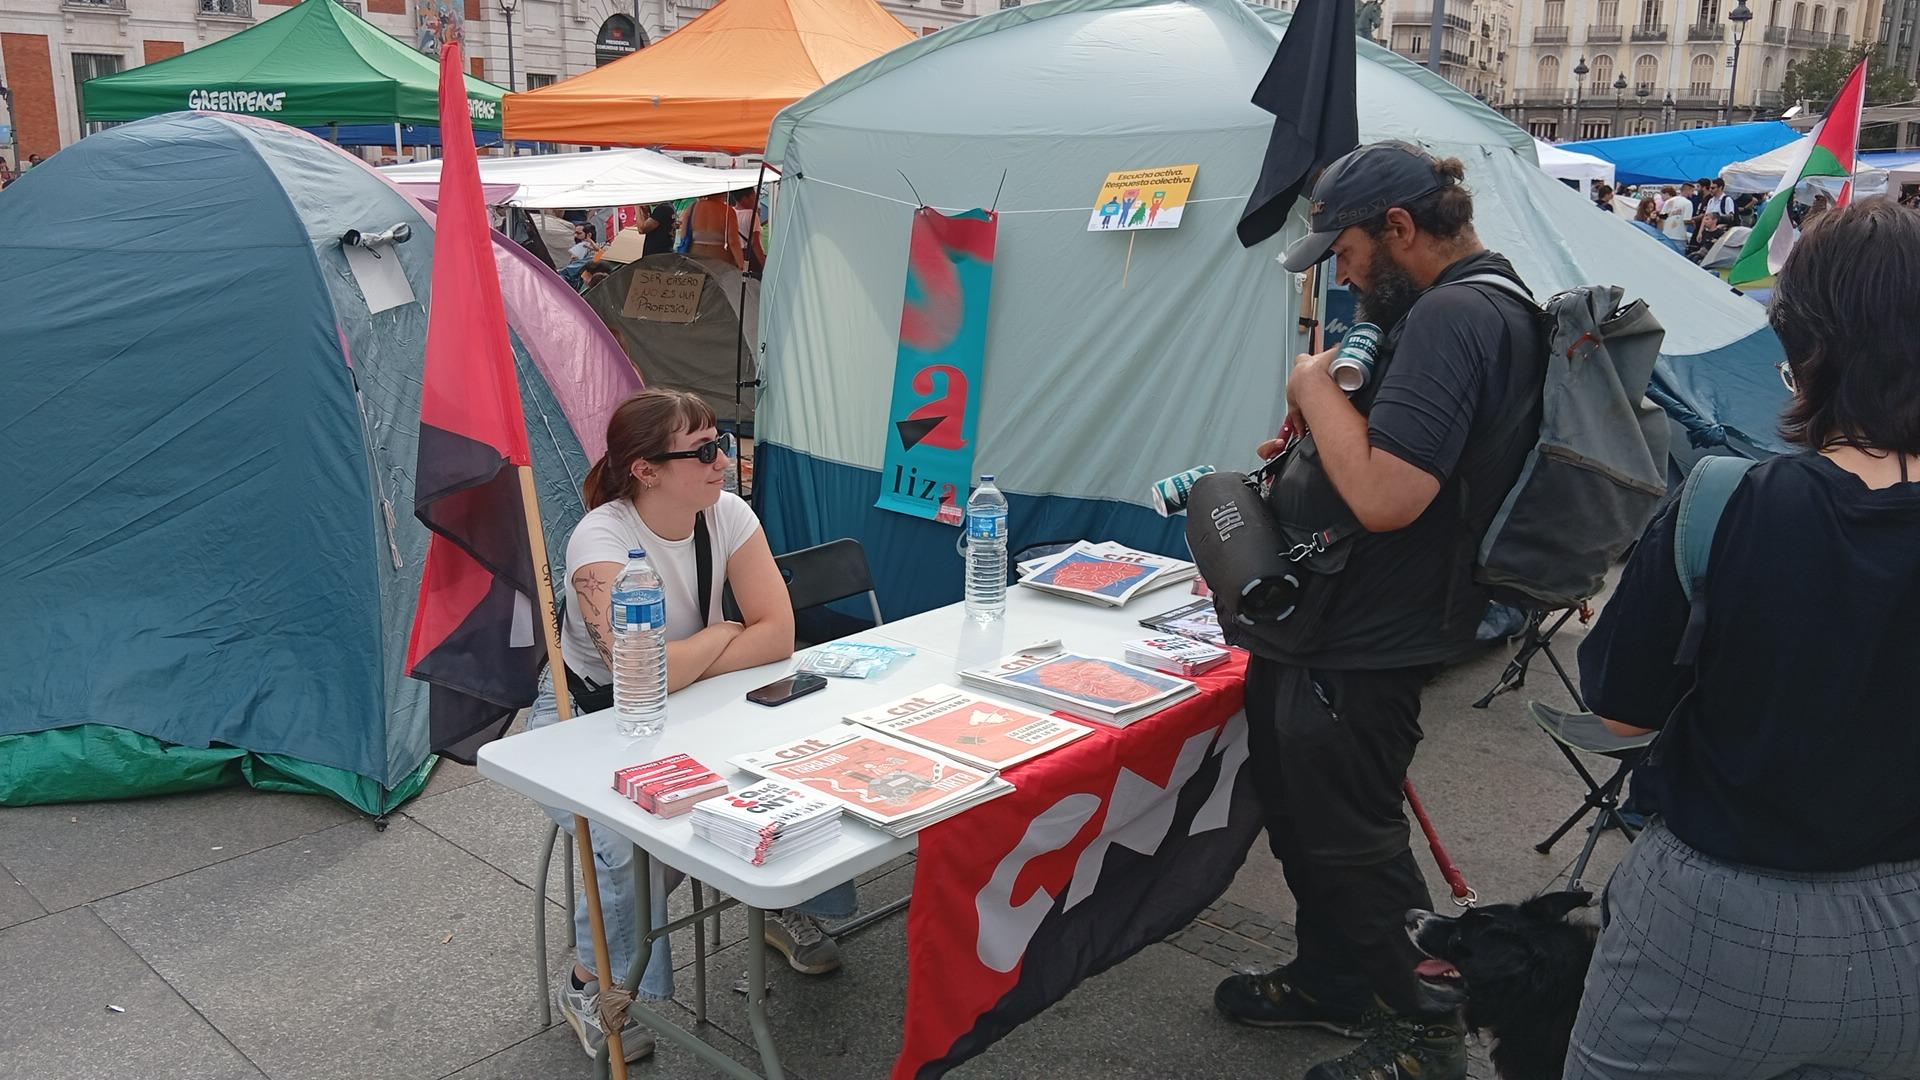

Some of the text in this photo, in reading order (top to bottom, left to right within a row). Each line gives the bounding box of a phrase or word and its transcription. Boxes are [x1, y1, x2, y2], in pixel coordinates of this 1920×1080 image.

[188, 89, 286, 112] GREENPEACE
[1104, 176, 1192, 190] Respuesta colectiva.
[1117, 169, 1183, 181] Escucha activa.
[640, 272, 699, 287] SER CASERO
[660, 289, 676, 299] ES
[1348, 336, 1377, 351] Maho
[1210, 501, 1245, 543] JBL
[887, 697, 936, 716] cnt
[775, 739, 831, 759] cnt
[975, 708, 1250, 973] CNT
